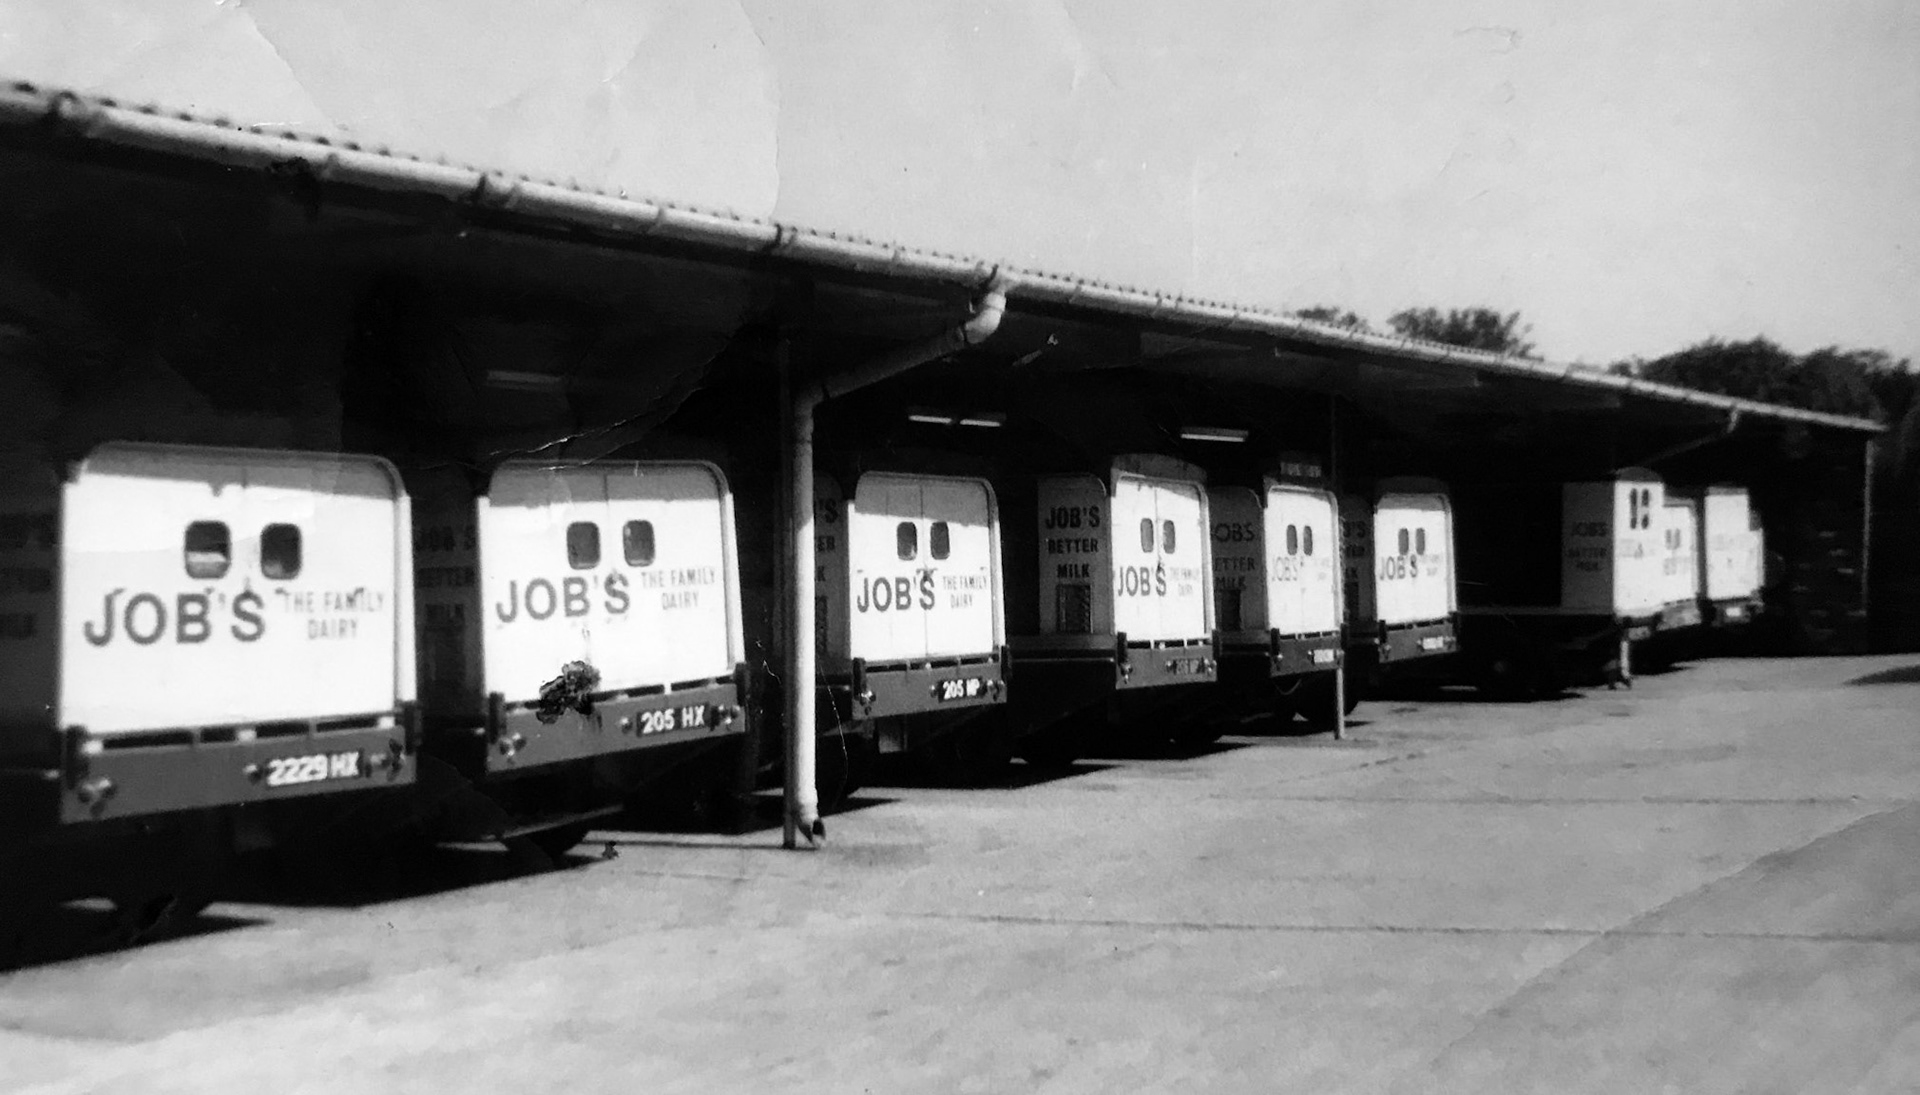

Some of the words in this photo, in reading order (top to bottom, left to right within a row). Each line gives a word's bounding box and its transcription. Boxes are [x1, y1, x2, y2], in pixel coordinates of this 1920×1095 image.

[1045, 505, 1100, 529] JOB'S
[1048, 538, 1098, 555] BETTER
[641, 571, 665, 589] THE
[671, 566, 716, 586] FAMILY
[943, 575, 958, 590] THE
[960, 574, 988, 590] FAMILY
[1057, 564, 1090, 578] MILK
[1117, 565, 1167, 597] JOB'S
[283, 591, 315, 614] THE
[323, 590, 386, 614] FAMILY
[496, 573, 631, 624] JOB'S
[662, 592, 701, 611] DAIRY
[857, 575, 936, 613] JOB'S
[950, 594, 974, 609] DAIRY
[83, 590, 266, 648] JOB'S
[307, 618, 359, 641] DAIRY
[942, 679, 964, 700] 205
[641, 708, 675, 734] 205
[682, 705, 705, 728] HX
[268, 754, 328, 785] 2229
[331, 751, 359, 777] HX
